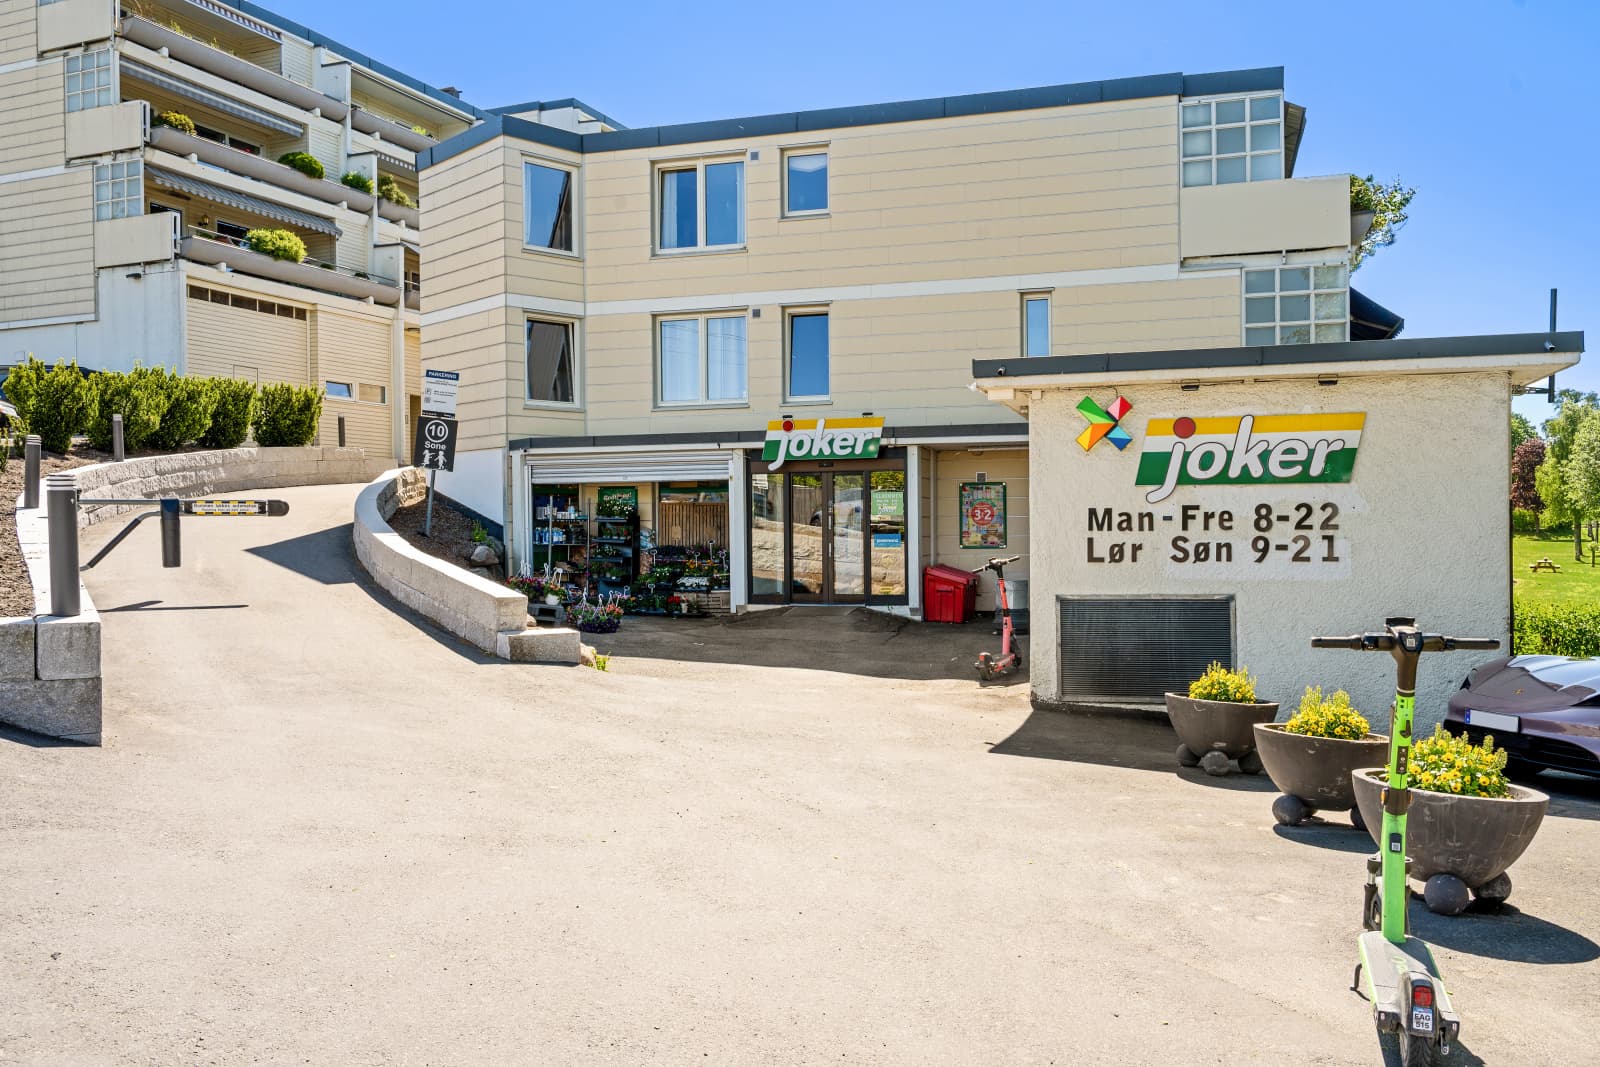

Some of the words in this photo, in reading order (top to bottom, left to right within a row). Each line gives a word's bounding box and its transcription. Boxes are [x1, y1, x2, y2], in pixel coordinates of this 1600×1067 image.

[428, 371, 457, 379] PARKERING
[429, 425, 445, 437] 10
[424, 441, 447, 451] Sone
[768, 419, 873, 471] joker
[1146, 415, 1345, 504] joker
[974, 509, 981, 520] 3
[984, 509, 992, 520] 2
[1253, 503, 1340, 532] 8-22
[1087, 537, 1143, 564] Lør
[1170, 536, 1233, 564] Søn
[1251, 535, 1340, 563] 9-21
[1414, 1013, 1431, 1021] EAG
[1415, 1021, 1430, 1029] 515
